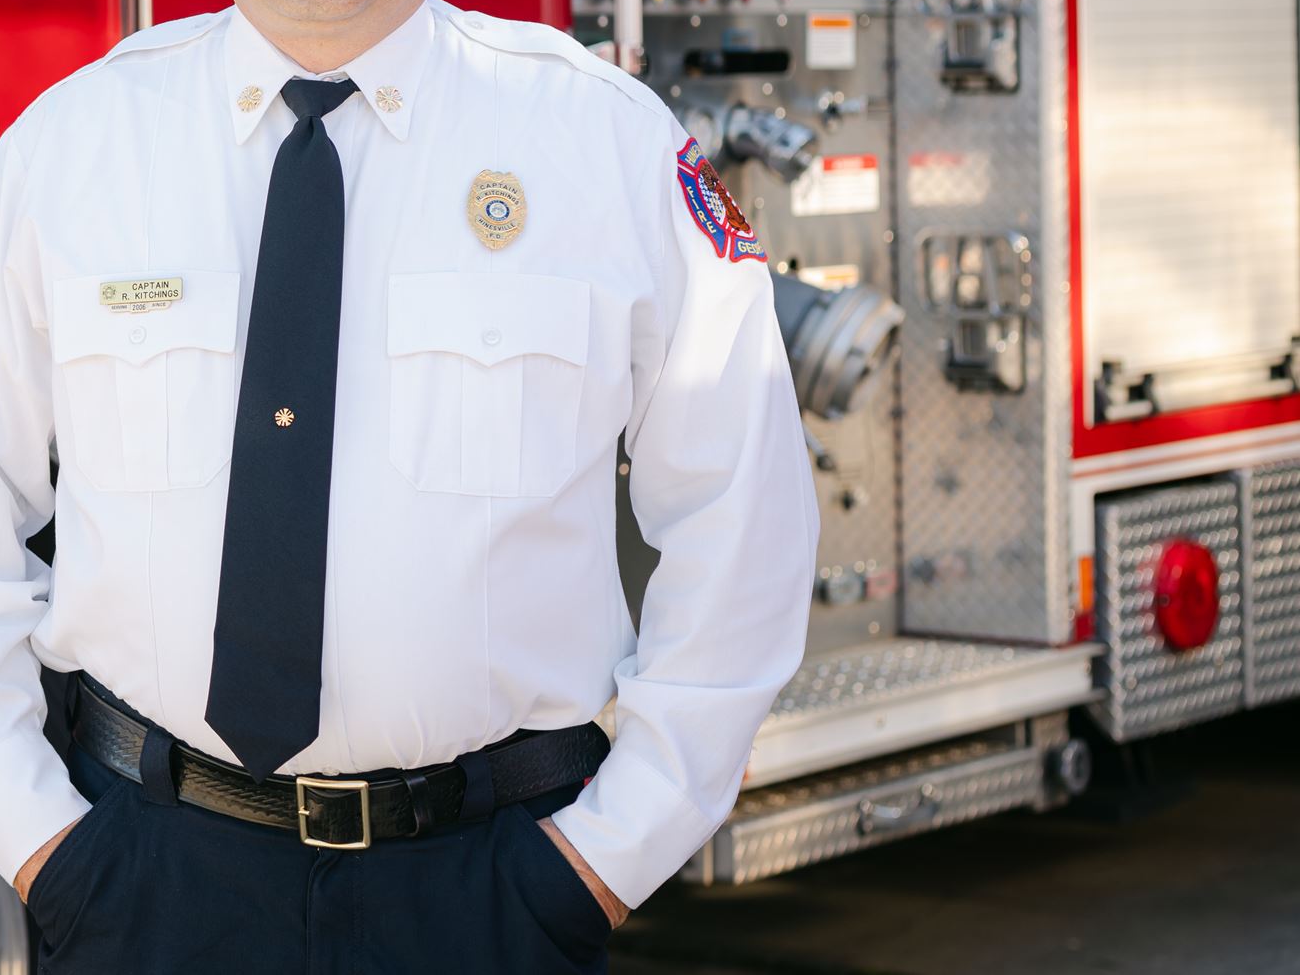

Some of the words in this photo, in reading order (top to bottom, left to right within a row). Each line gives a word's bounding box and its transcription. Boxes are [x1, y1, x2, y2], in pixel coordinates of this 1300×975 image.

[480, 183, 518, 194] CAPTAIN
[484, 190, 520, 205] KITCHINGS
[686, 186, 716, 234] FIRE
[479, 219, 515, 231] HINESVILLE
[132, 281, 169, 290] CAPTAIN
[135, 290, 179, 299] KITCHINGS
